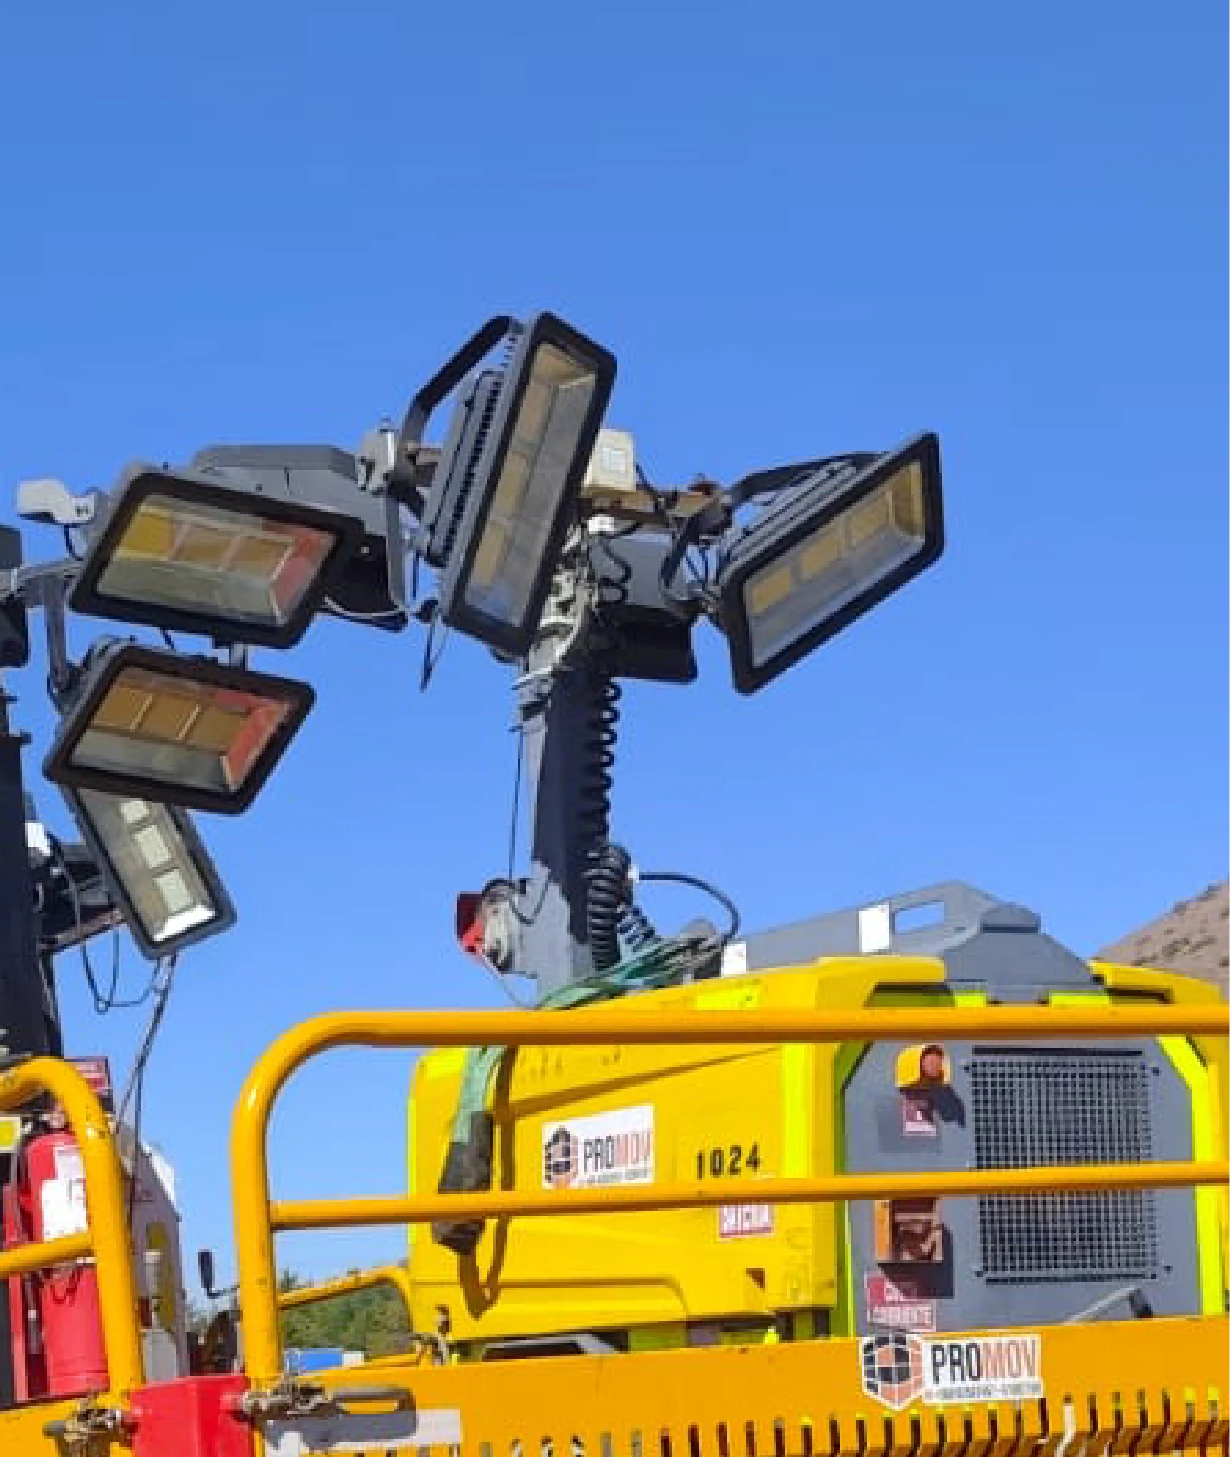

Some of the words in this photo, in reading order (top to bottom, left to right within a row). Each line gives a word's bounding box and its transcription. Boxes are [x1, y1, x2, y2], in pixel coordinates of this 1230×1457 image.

[583, 1132, 652, 1173] PROMOV
[696, 1142, 762, 1180] 1024
[930, 1340, 1038, 1385] PROMOV
